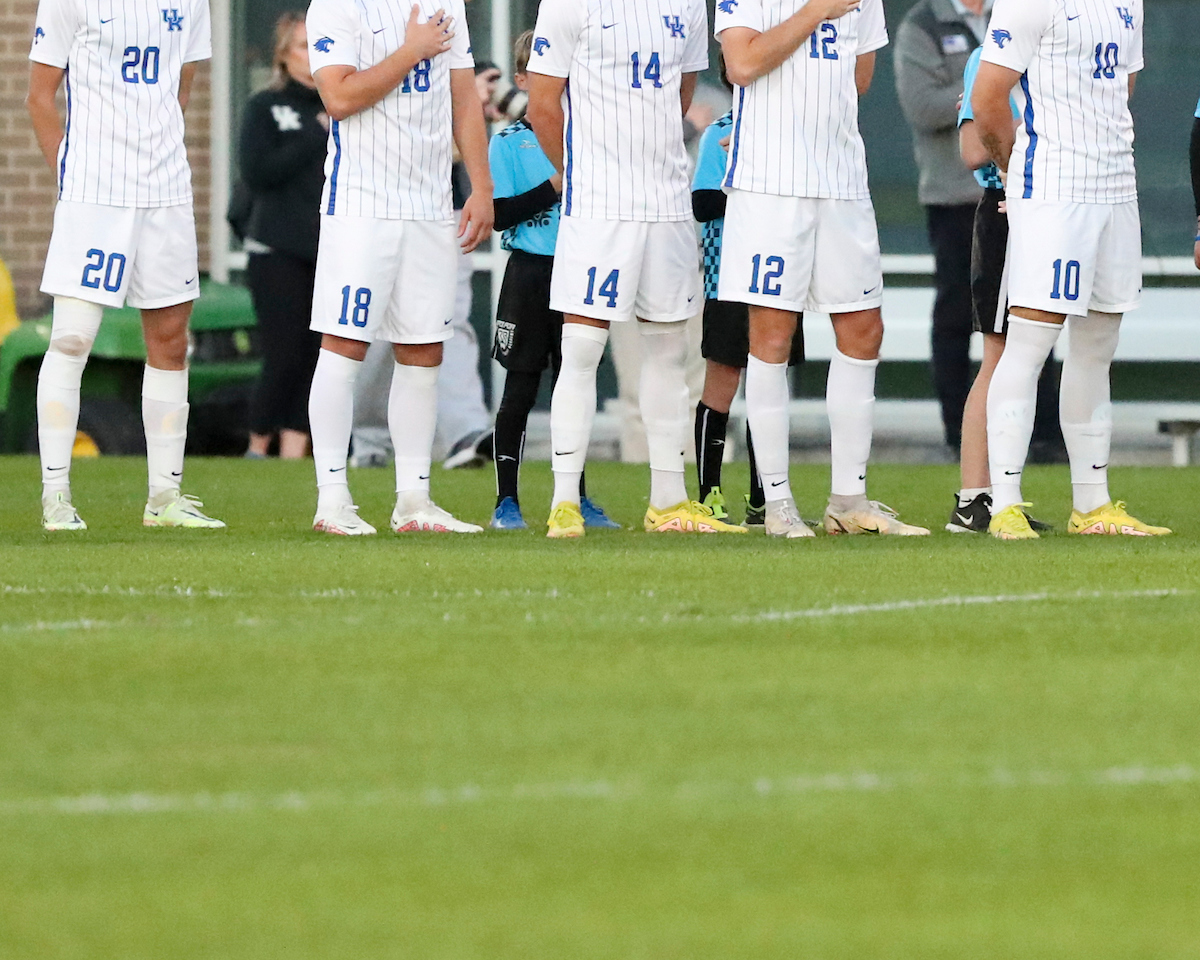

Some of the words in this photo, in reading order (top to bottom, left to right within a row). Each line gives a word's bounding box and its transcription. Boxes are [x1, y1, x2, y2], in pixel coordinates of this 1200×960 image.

[161, 8, 184, 31] UK
[662, 15, 686, 39] UK
[1116, 7, 1135, 30] UK
[809, 23, 839, 60] 12
[1093, 42, 1119, 79] 10
[121, 46, 160, 84] 20
[630, 51, 662, 89] 14
[80, 248, 126, 293] 20
[583, 266, 620, 308] 14
[748, 253, 785, 296] 12
[1049, 258, 1080, 301] 10
[338, 285, 372, 328] 18
